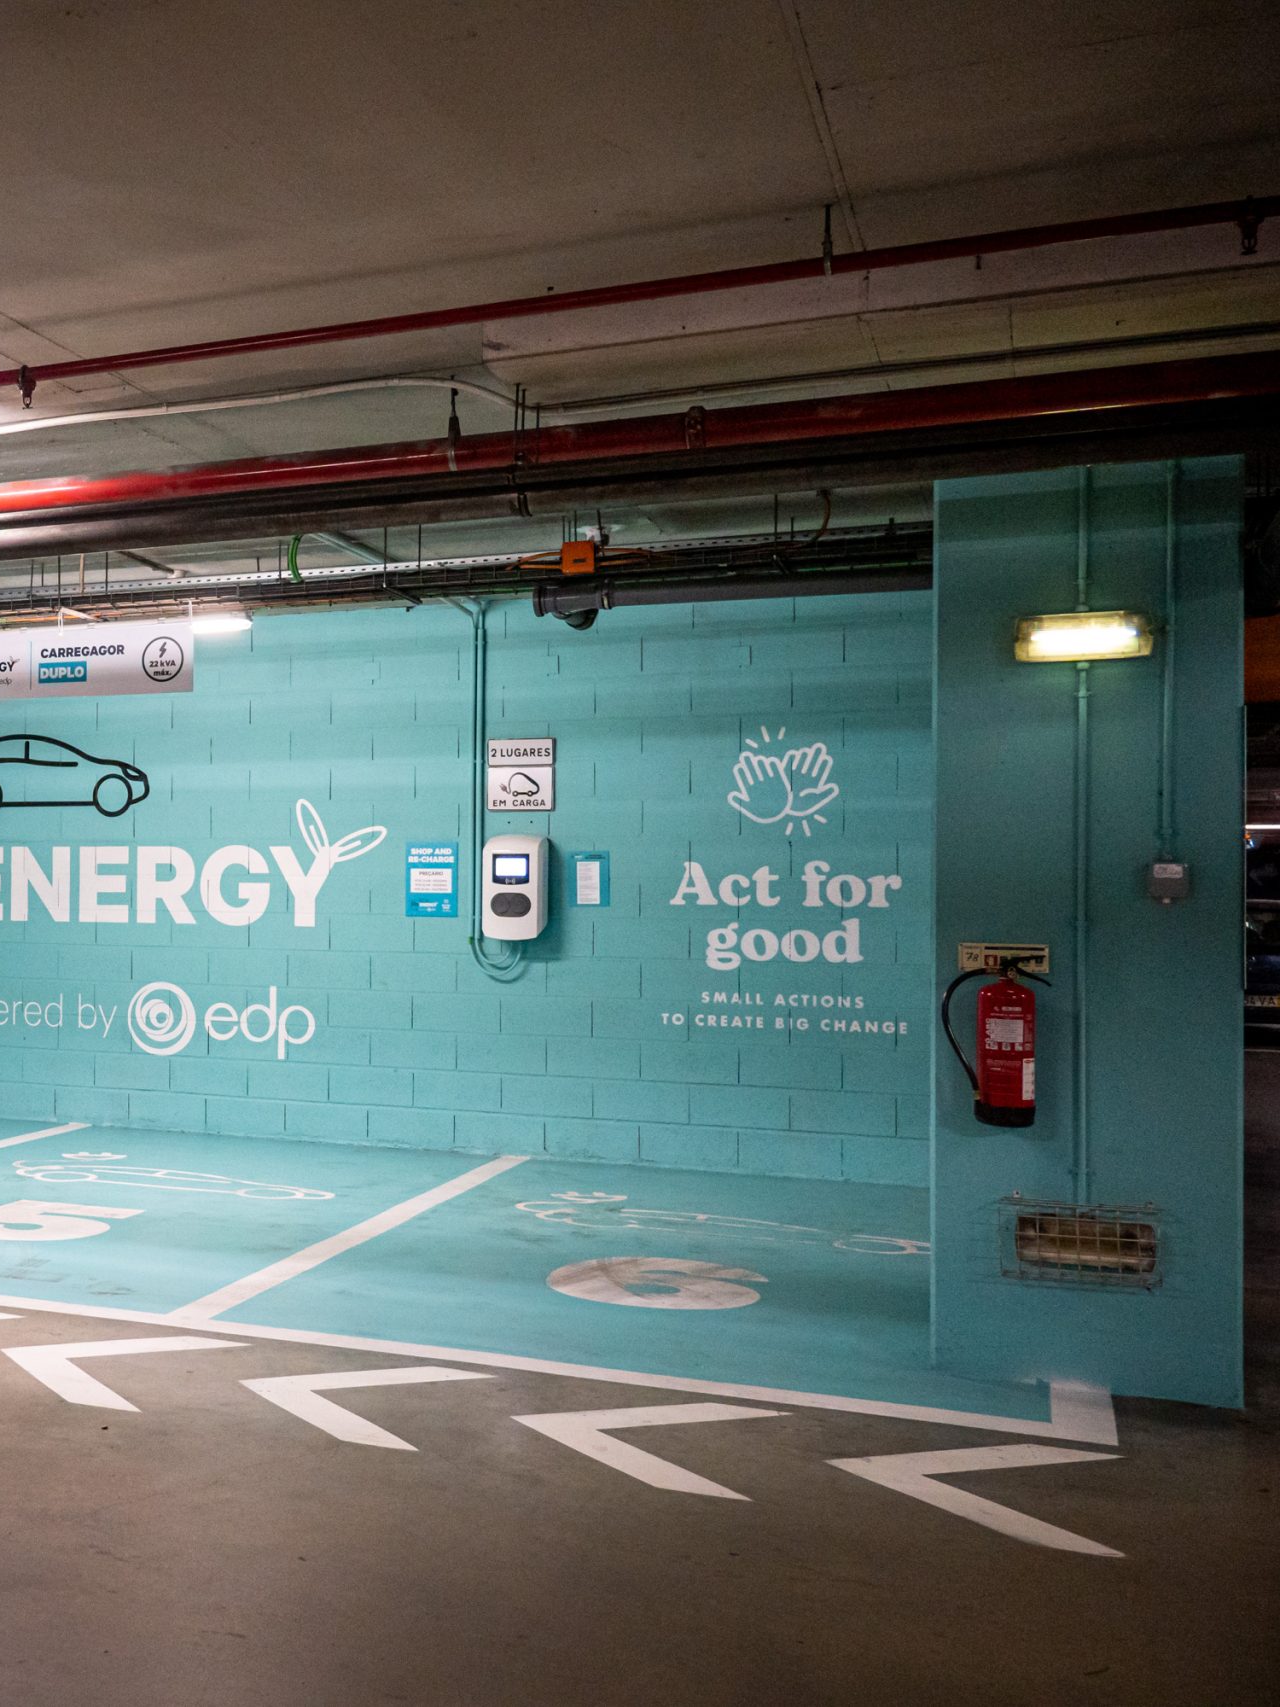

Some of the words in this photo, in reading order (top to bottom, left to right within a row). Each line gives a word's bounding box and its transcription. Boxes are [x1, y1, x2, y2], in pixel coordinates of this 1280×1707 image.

[40, 644, 125, 659] CARREGAGOR
[149, 660, 159, 668] 22
[160, 659, 176, 667] kVA
[39, 665, 84, 679] DUPLO
[490, 748, 497, 758] 2
[500, 747, 551, 758] LUGARES
[492, 799, 507, 807] EM
[512, 799, 546, 807] CARGA
[410, 847, 433, 855] SHOP
[434, 847, 452, 855] AND
[408, 855, 455, 863] RE-CHARGE
[669, 861, 781, 907] Act
[801, 860, 903, 908] for
[705, 918, 864, 971] good
[700, 991, 765, 1006] SMALL
[773, 994, 865, 1009] ACTIONS
[78, 992, 117, 1038] by
[204, 985, 316, 1060] edp
[661, 1012, 685, 1026] TO
[695, 1014, 765, 1029] CREATE
[775, 1017, 810, 1030] BIG
[821, 1019, 908, 1035] CHANGE
[546, 1256, 769, 1310] 6
